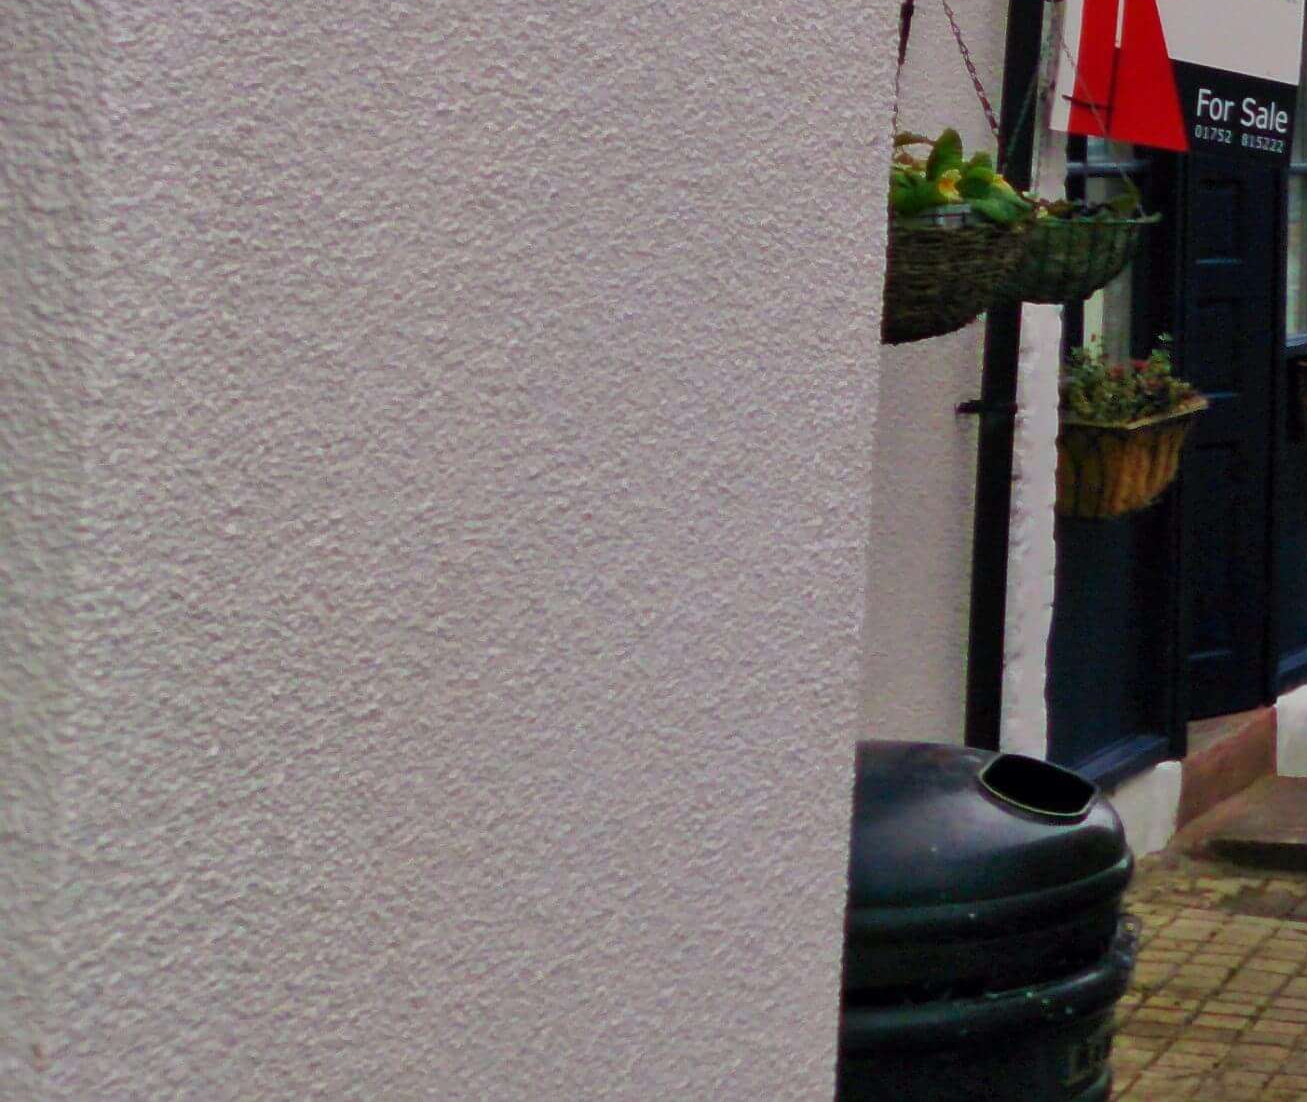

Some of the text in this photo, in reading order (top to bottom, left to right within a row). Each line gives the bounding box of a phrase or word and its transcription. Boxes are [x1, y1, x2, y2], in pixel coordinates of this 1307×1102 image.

[1196, 88, 1289, 133] For Sale
[1194, 124, 1233, 144] 01752
